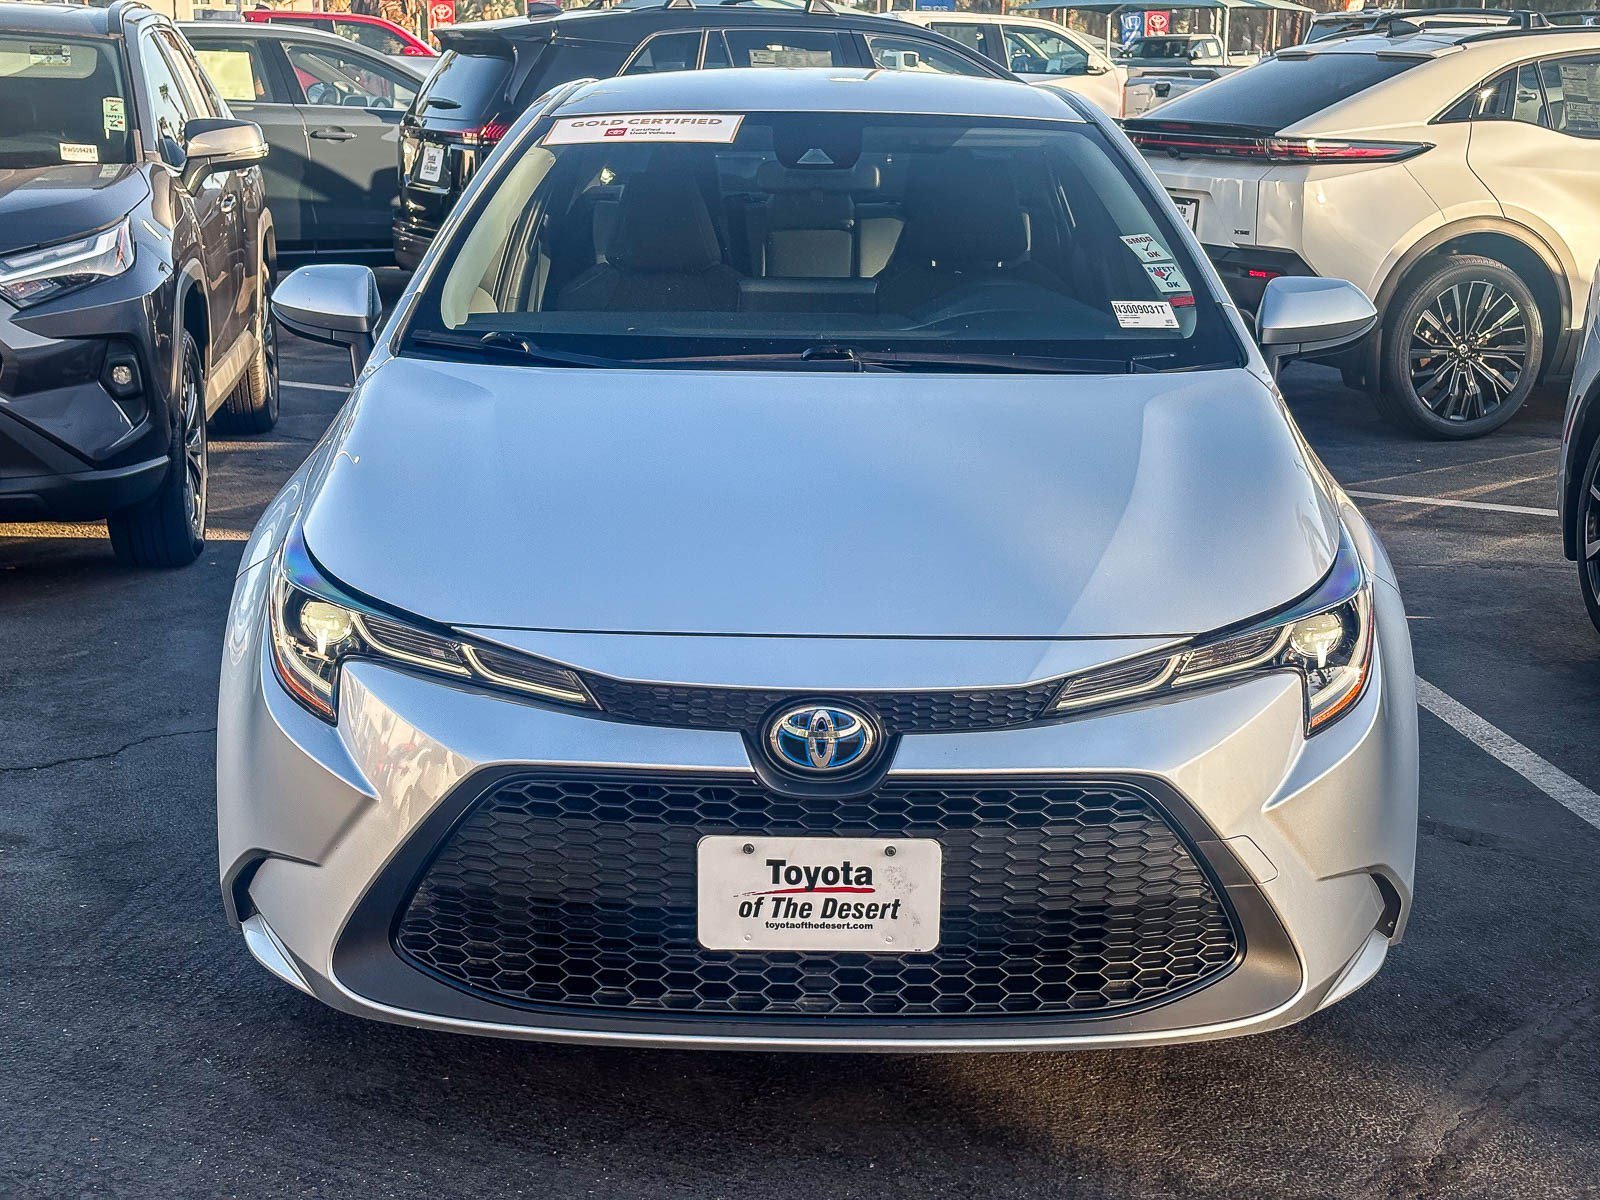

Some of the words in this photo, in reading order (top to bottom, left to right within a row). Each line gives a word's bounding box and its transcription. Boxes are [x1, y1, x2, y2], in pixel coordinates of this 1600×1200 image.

[571, 119, 624, 128] GOLD
[627, 118, 723, 126] CERTIFIED
[1125, 236, 1154, 245] SMOG
[1146, 265, 1177, 274] SAFETY
[1113, 304, 1166, 315] N3009031T
[766, 859, 873, 892] Toyota
[738, 896, 765, 918] of
[771, 896, 813, 919] The
[820, 897, 901, 920] Desert
[765, 920, 874, 930] toyotaofthedesert.com
